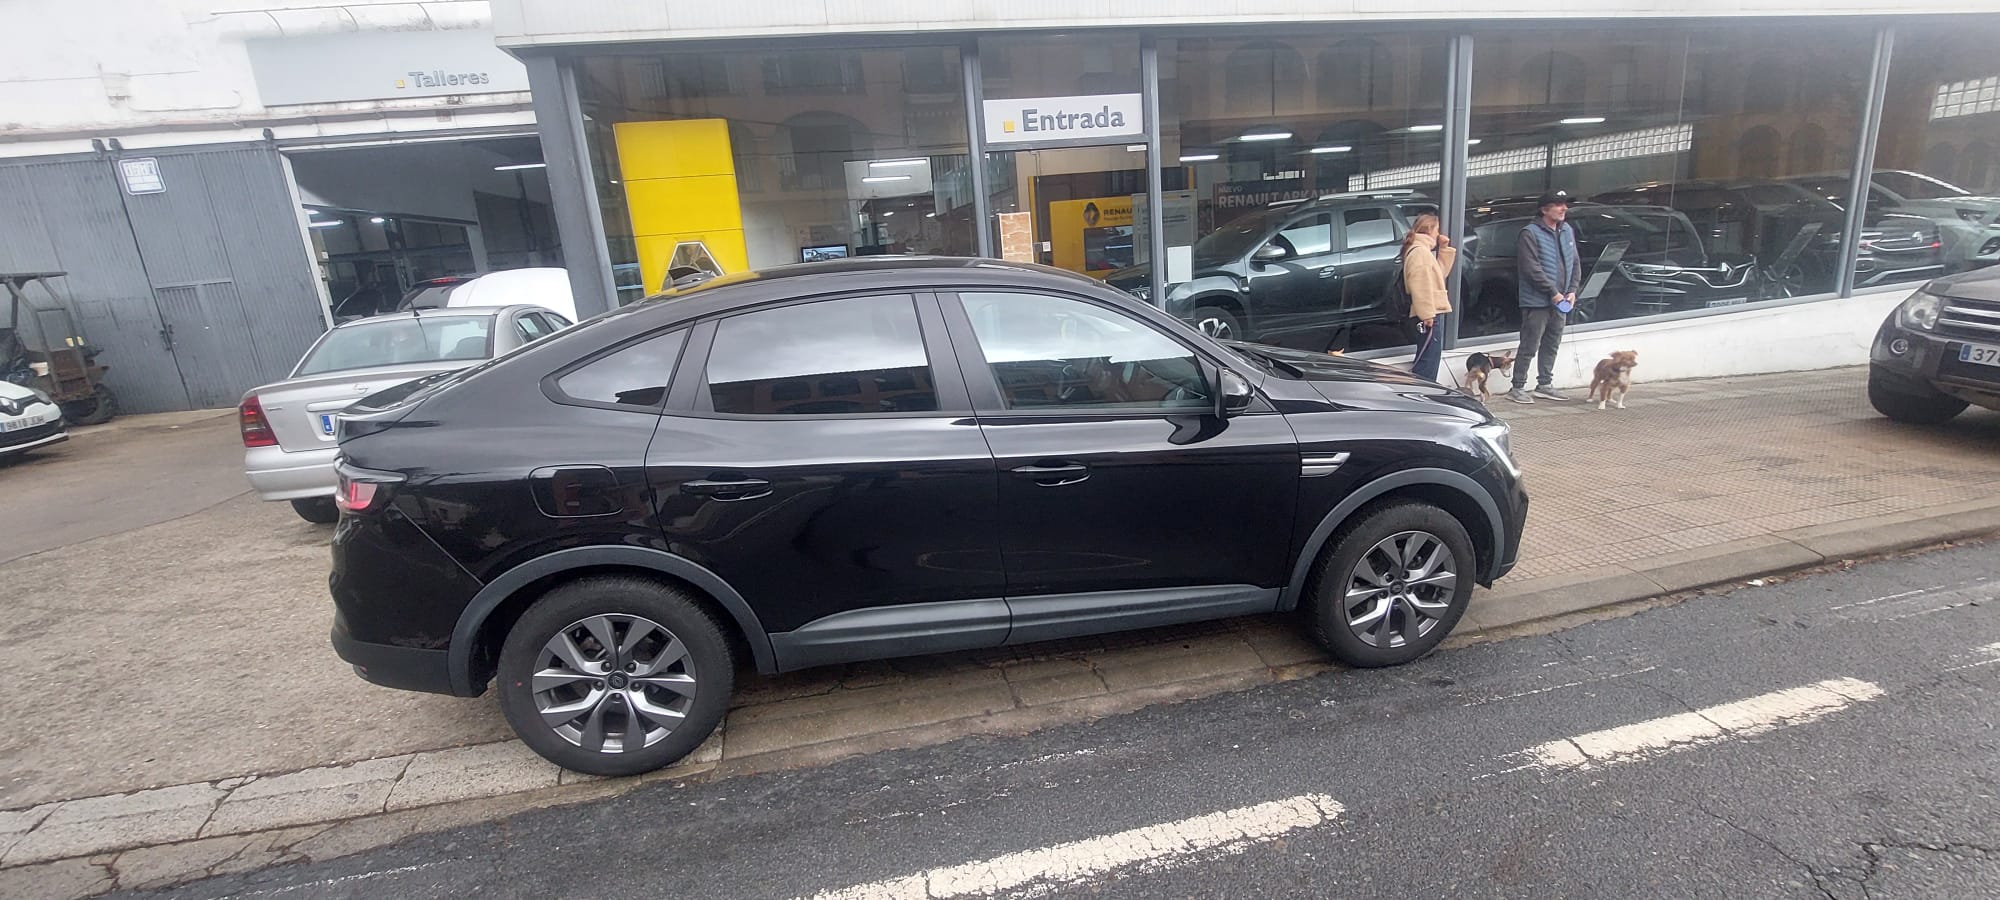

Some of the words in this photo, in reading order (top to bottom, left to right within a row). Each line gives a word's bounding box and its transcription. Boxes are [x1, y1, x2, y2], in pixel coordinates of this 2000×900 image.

[408, 70, 490, 88] Talleres
[1022, 105, 1126, 132] Entrada
[1218, 184, 1243, 194] NUEVO
[1218, 192, 1280, 208] RENAULT
[1973, 348, 2000, 364] 37
